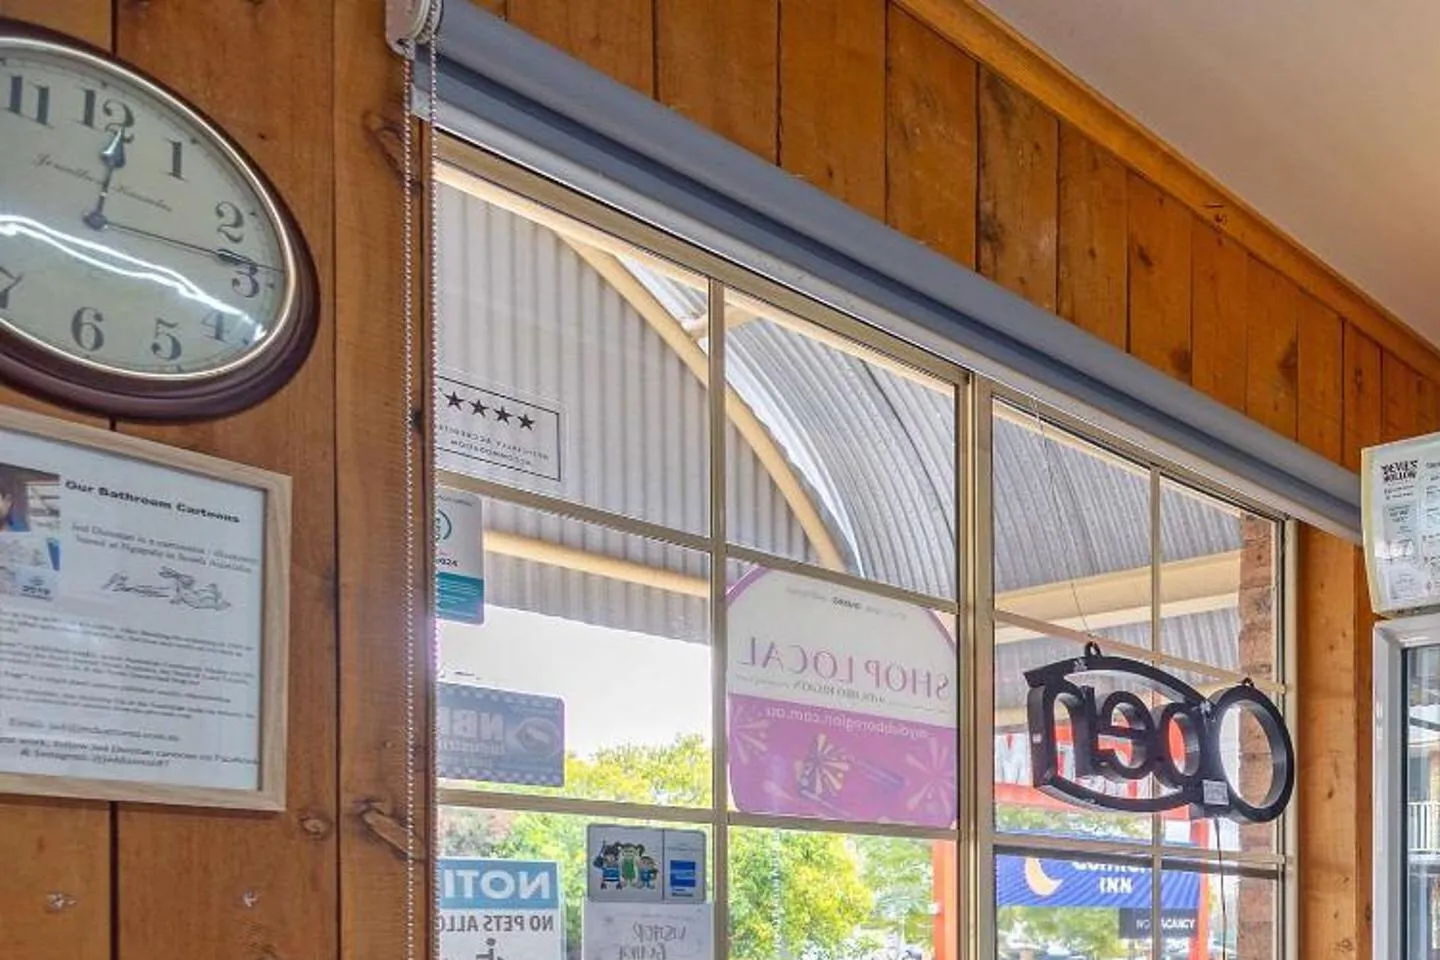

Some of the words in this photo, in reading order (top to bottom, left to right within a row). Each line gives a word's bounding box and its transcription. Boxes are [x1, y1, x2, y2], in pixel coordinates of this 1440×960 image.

[8, 75, 52, 126] 11
[78, 88, 135, 146] 12
[168, 140, 186, 181] 1
[216, 200, 245, 243] 2
[231, 263, 260, 299] 3
[71, 306, 105, 351] 6
[151, 317, 183, 362] 5
[200, 309, 231, 342] 4
[65, 480, 94, 493] Our
[98, 486, 172, 509] Bathroom
[176, 502, 240, 524] Cartoons
[1099, 877, 1133, 894] INN
[1161, 918, 1195, 930] ACANCY
